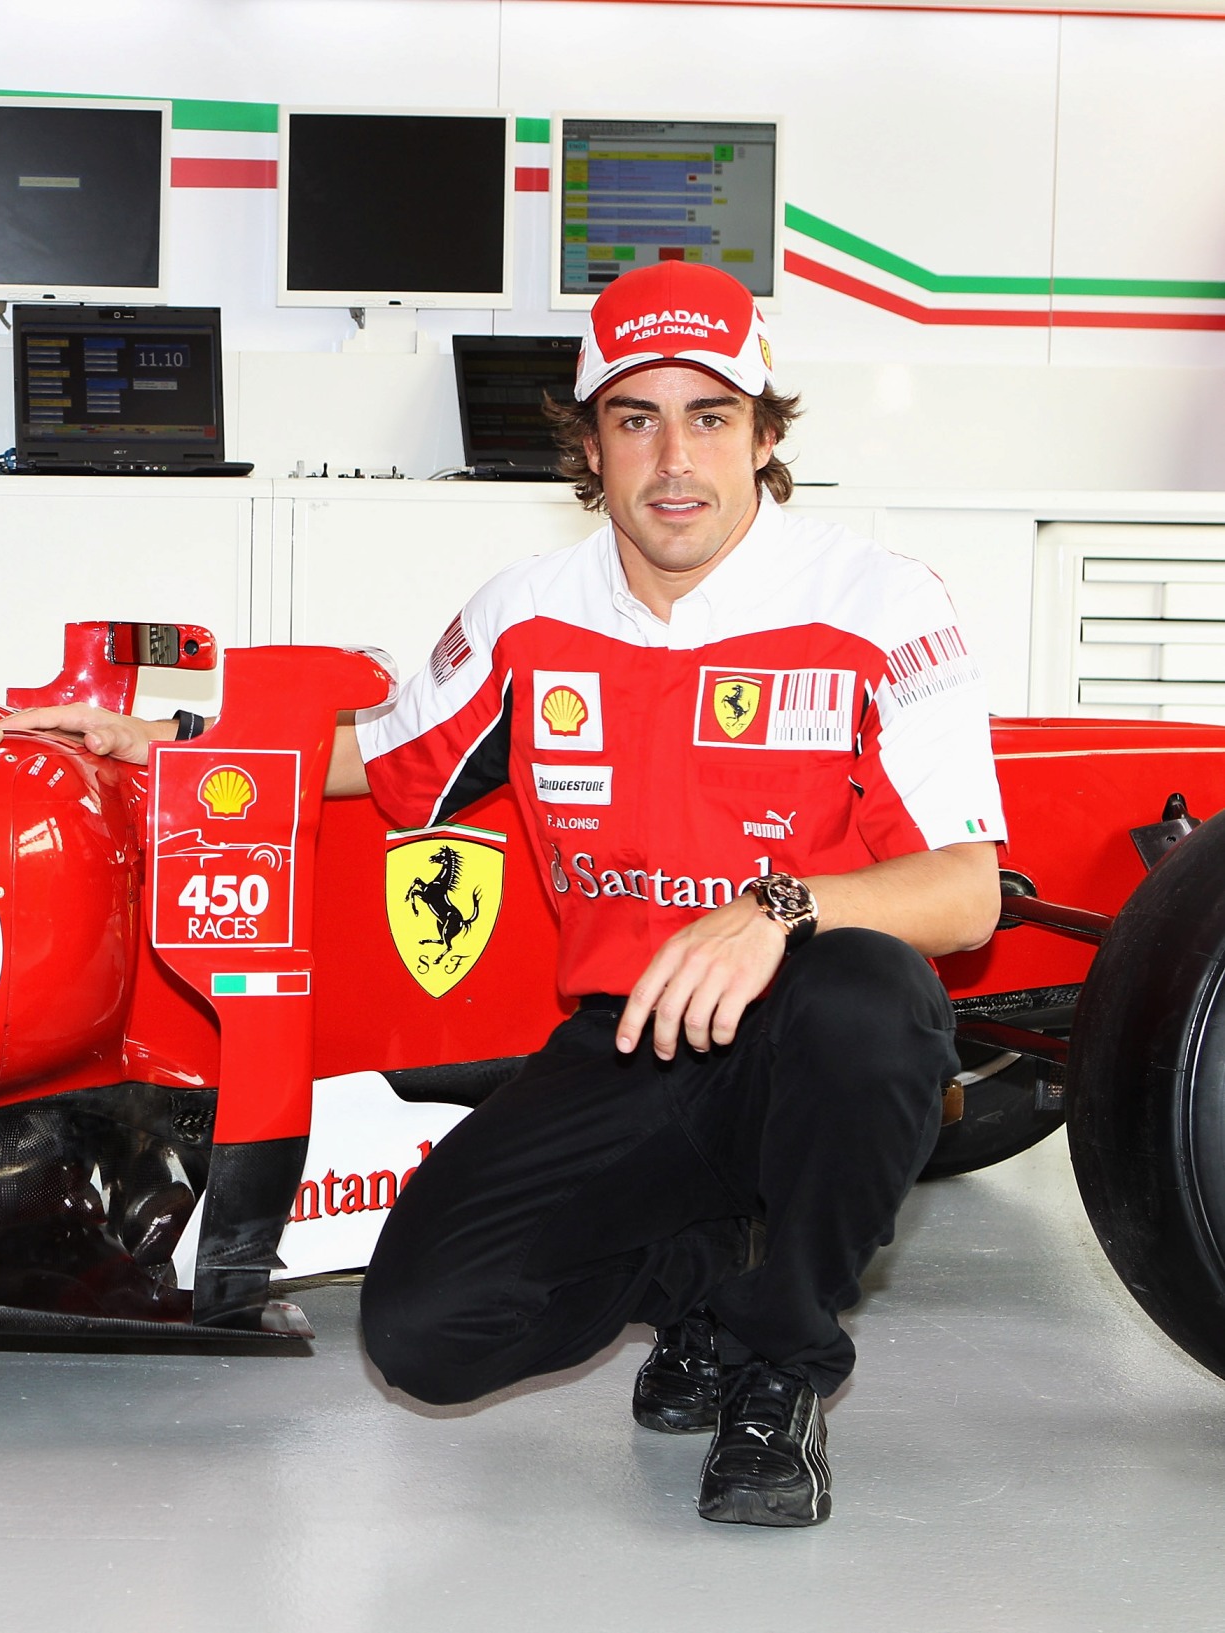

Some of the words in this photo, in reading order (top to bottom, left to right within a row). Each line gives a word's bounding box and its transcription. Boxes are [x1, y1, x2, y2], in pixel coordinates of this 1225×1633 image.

[615, 309, 730, 341] MUBADALA
[632, 325, 662, 342] ABU
[663, 325, 709, 339] DHABI
[138, 352, 184, 367] 11.10
[539, 777, 605, 792] BRIDGESTONE
[743, 821, 785, 840] PUMA
[178, 874, 269, 916] 450
[188, 917, 258, 939] RACES
[286, 1139, 433, 1225] ntan
